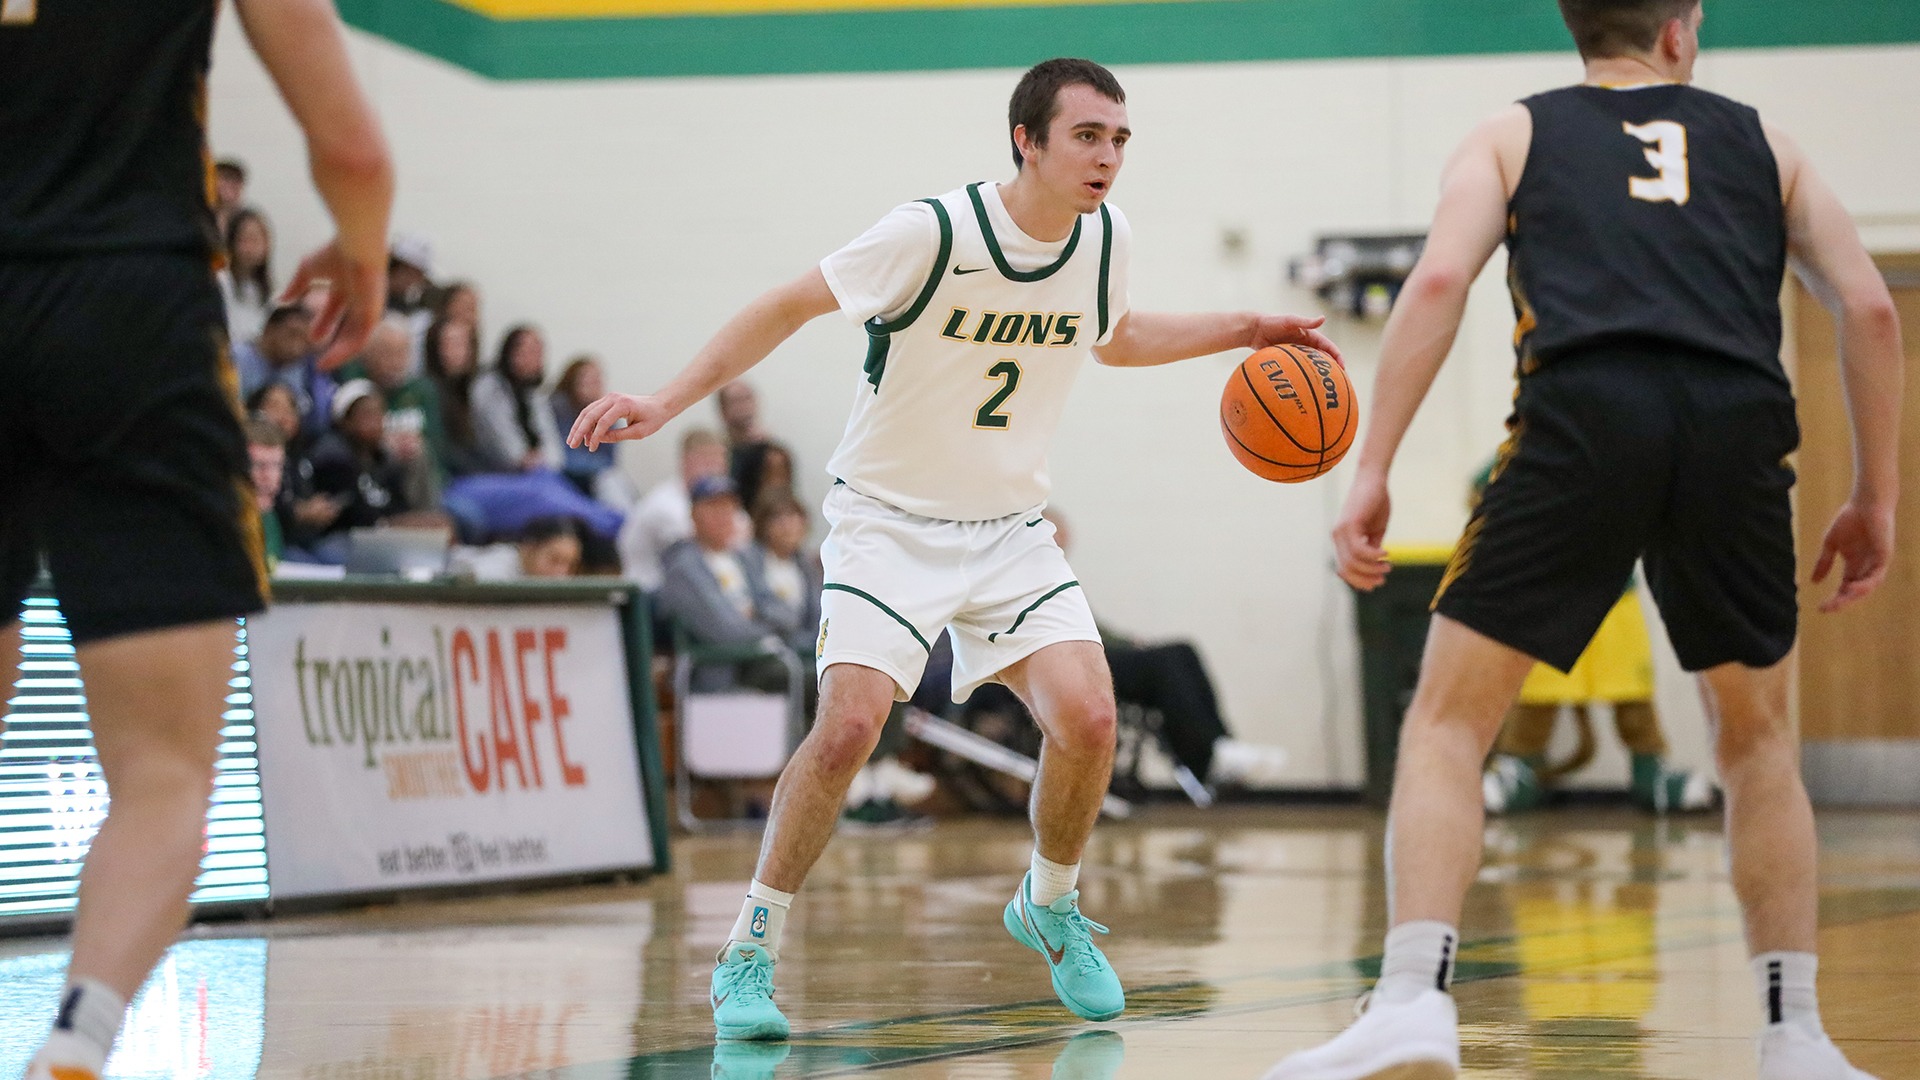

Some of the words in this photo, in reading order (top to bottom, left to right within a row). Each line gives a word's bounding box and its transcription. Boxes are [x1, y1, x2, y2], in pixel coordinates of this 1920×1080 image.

[1622, 119, 1690, 206] 3
[939, 306, 1083, 348] LIONS
[972, 358, 1024, 431] 2
[293, 624, 452, 769] tropical
[450, 627, 587, 795] CAFE
